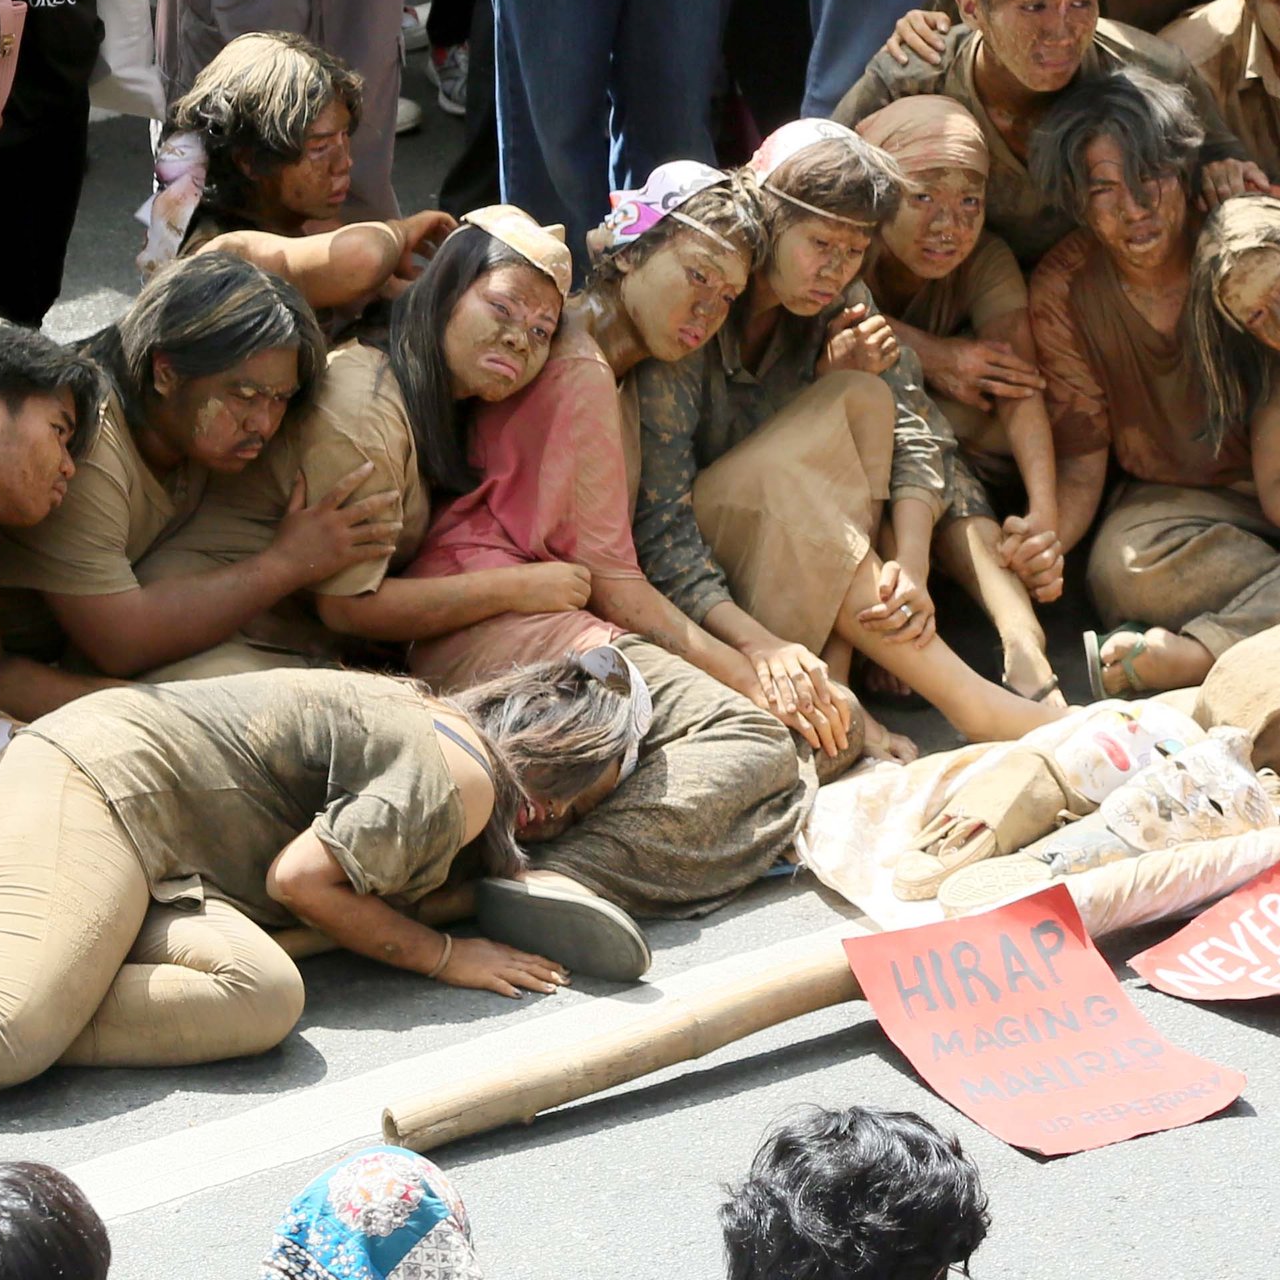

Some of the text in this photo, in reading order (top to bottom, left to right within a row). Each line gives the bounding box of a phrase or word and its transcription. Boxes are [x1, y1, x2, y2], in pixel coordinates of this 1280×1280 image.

[890, 920, 1067, 1019] HIRAP
[931, 995, 1119, 1062] MAGING
[960, 1037, 1166, 1104] MAHIRAP
